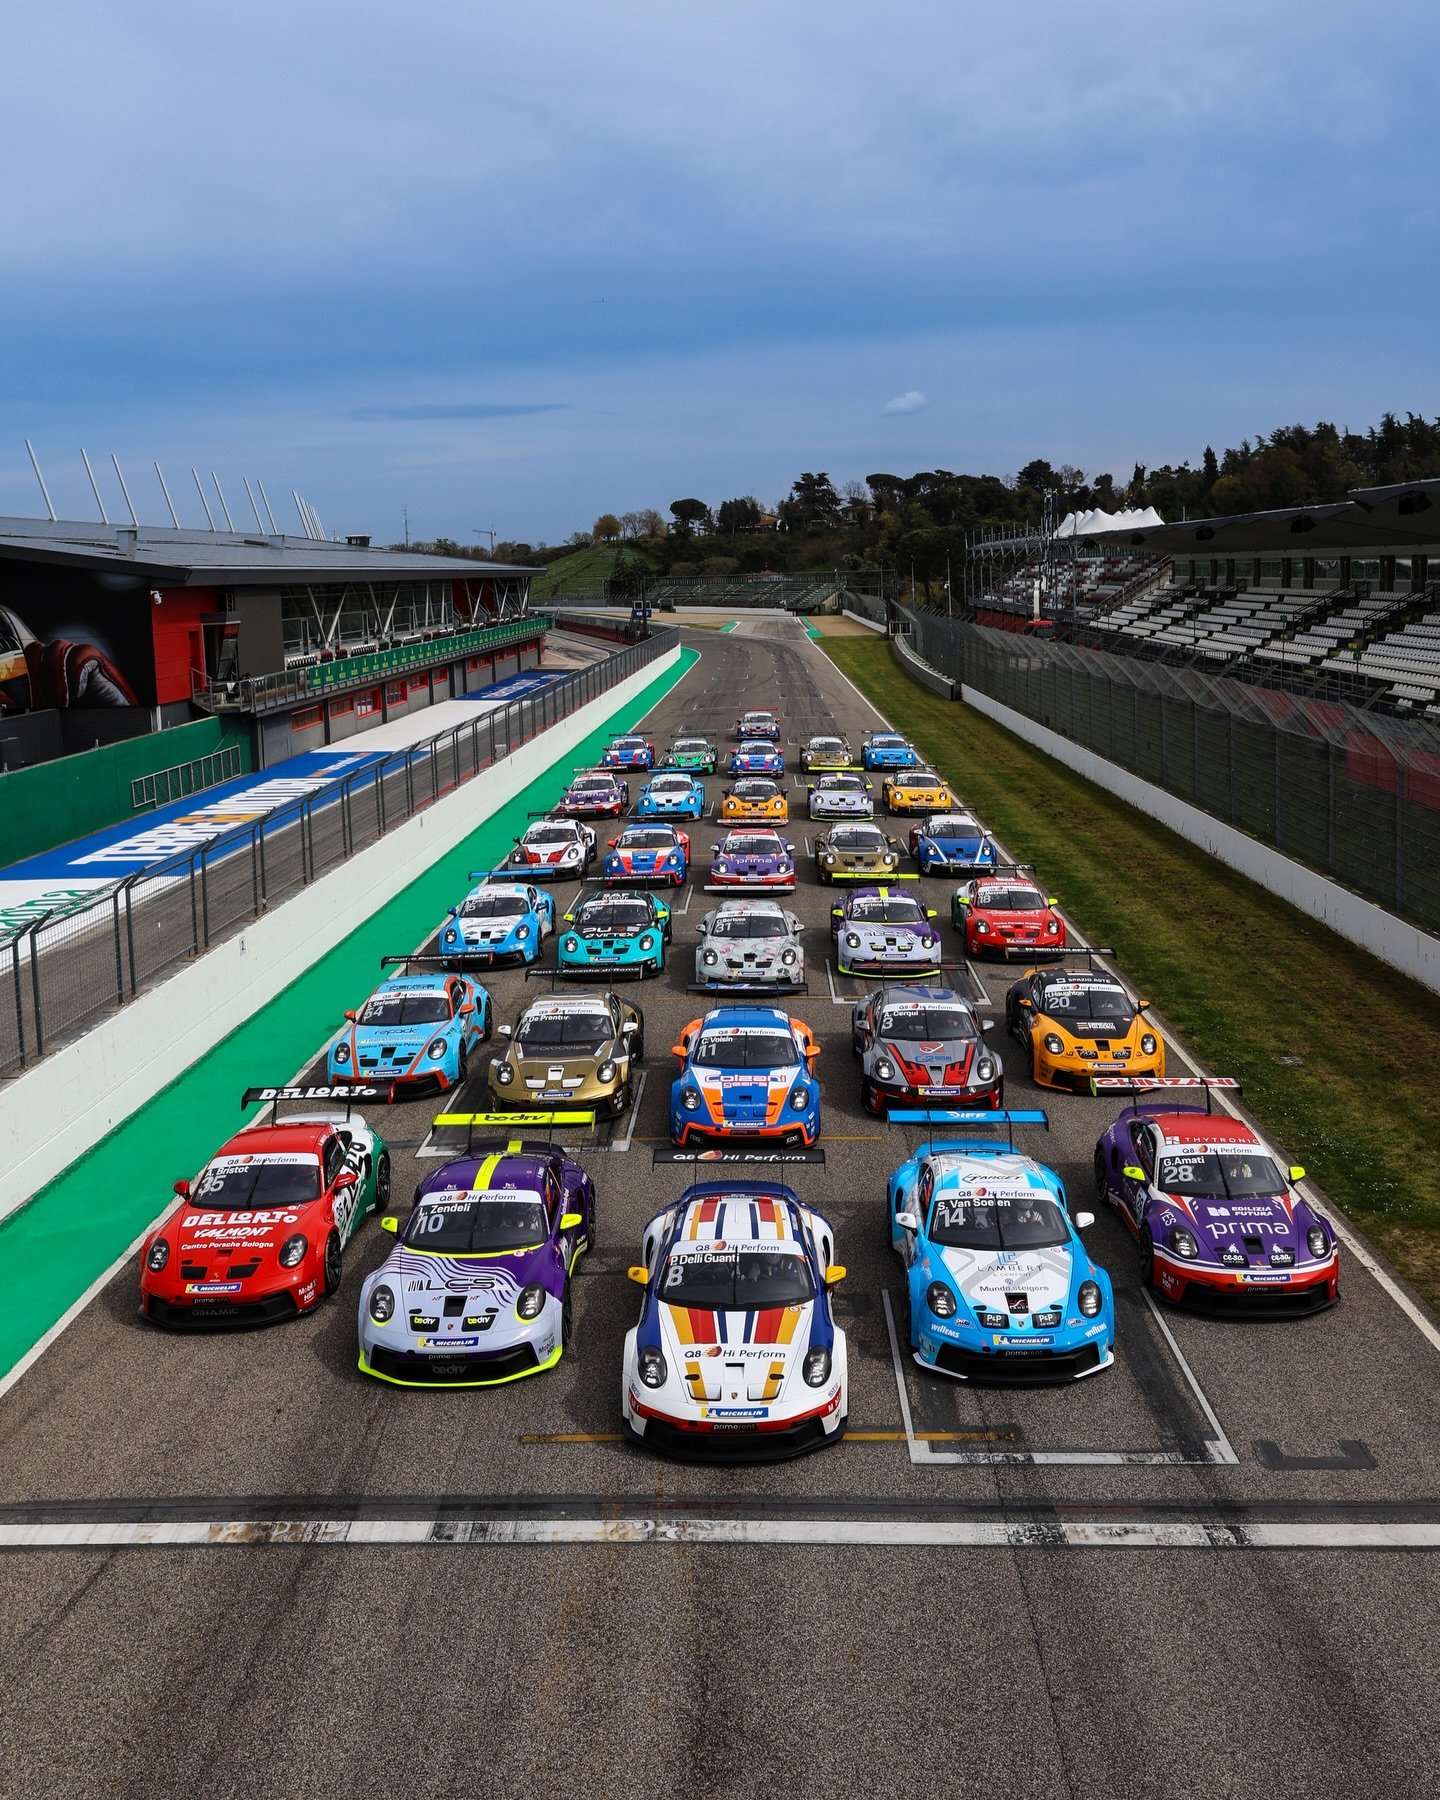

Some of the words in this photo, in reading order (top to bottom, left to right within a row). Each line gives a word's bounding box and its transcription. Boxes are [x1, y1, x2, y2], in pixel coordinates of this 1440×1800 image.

[852, 908, 868, 918] 21
[1048, 996, 1070, 1008] 20
[882, 1018, 894, 1030] 3
[698, 1044, 717, 1058] 11
[264, 1156, 298, 1164] Perform
[744, 1154, 806, 1162] Perform
[1163, 1156, 1205, 1166] G.Amati
[204, 1166, 214, 1178] A.
[216, 1165, 250, 1175] Bristot
[1163, 1165, 1194, 1184] 28
[198, 1174, 227, 1195] 35
[430, 1204, 472, 1214] Zendeli
[938, 1201, 950, 1211] S.
[950, 1200, 971, 1208] Van
[973, 1198, 1011, 1208] Soeen
[182, 1211, 299, 1228] DELLORTO
[416, 1214, 444, 1234] 10
[938, 1208, 966, 1228] 14
[1160, 1208, 1177, 1227] YES
[194, 1227, 274, 1239] VALMONT
[1206, 1222, 1290, 1240] prima
[741, 1244, 780, 1252] Perform
[704, 1252, 740, 1264] Guanti
[666, 1265, 684, 1287] 8
[1038, 1314, 1053, 1322] P&P
[930, 1324, 960, 1338] willems
[1084, 1322, 1108, 1338] willems
[684, 1350, 702, 1359] Q8
[723, 1350, 736, 1358] Hi
[739, 1350, 786, 1360] Perform
